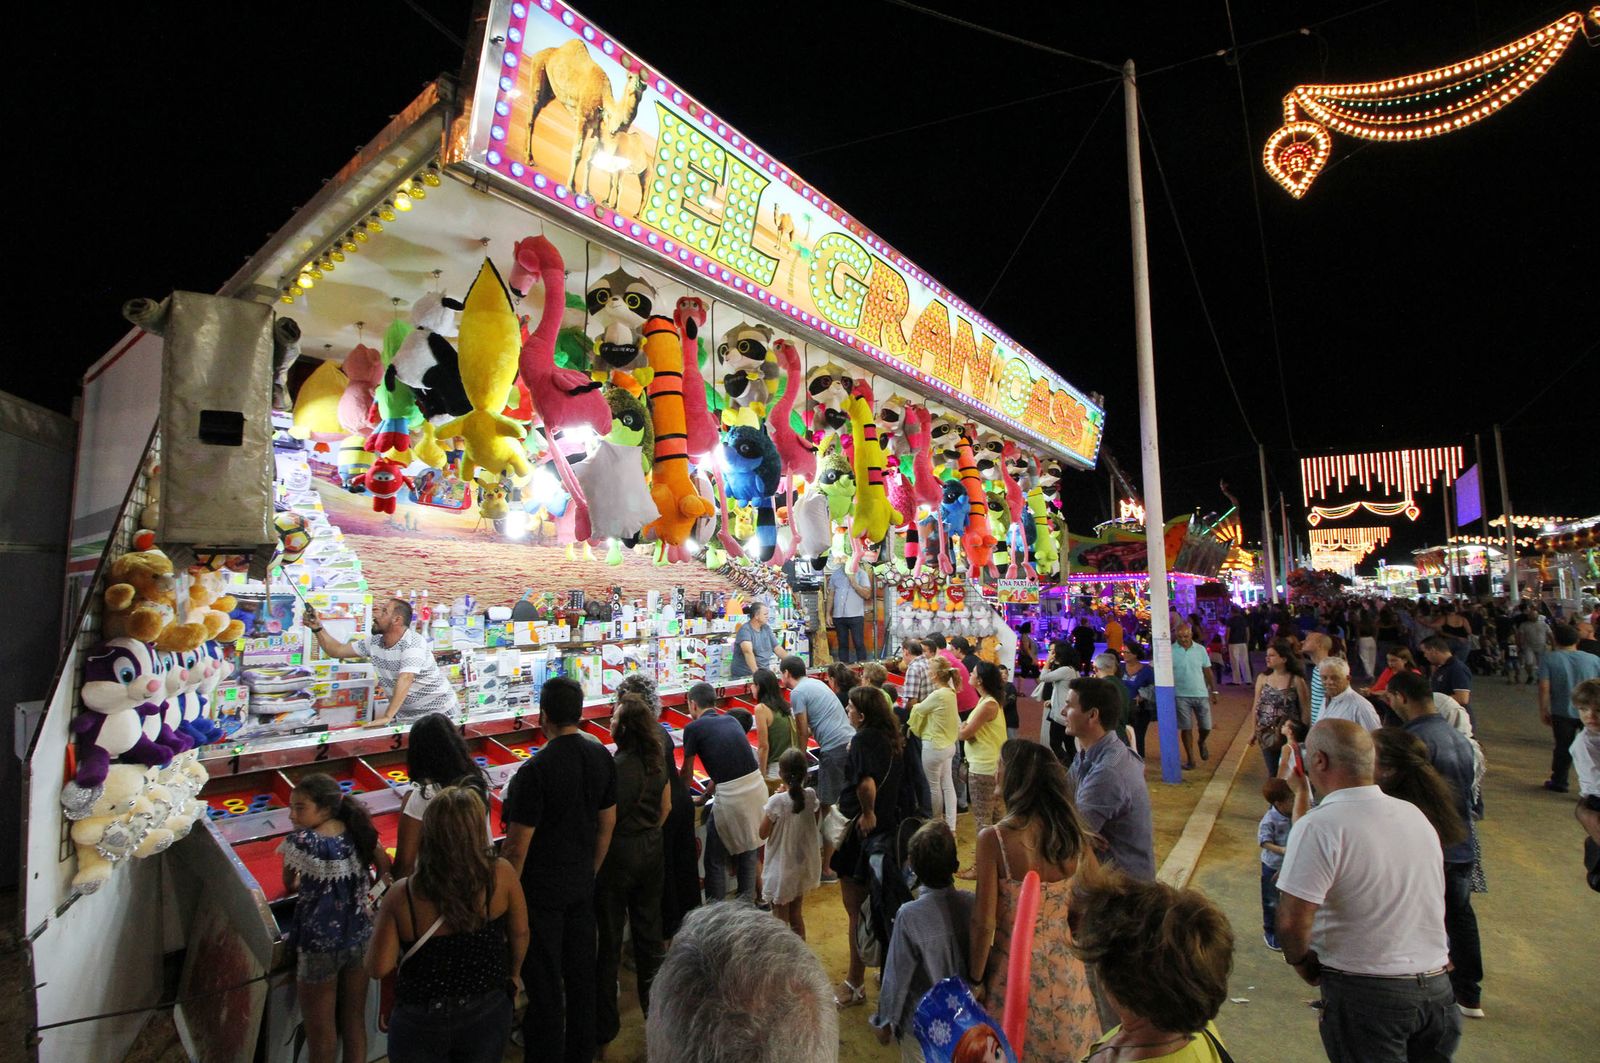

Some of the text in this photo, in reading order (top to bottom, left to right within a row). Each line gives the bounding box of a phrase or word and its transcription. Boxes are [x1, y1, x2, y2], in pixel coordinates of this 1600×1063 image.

[640, 101, 1086, 447] EL GRAN OASIS
[1013, 589, 1028, 600] 1€
[513, 716, 523, 731] 5
[390, 733, 402, 750] 3
[315, 743, 329, 762] 2
[228, 755, 240, 774] 1
